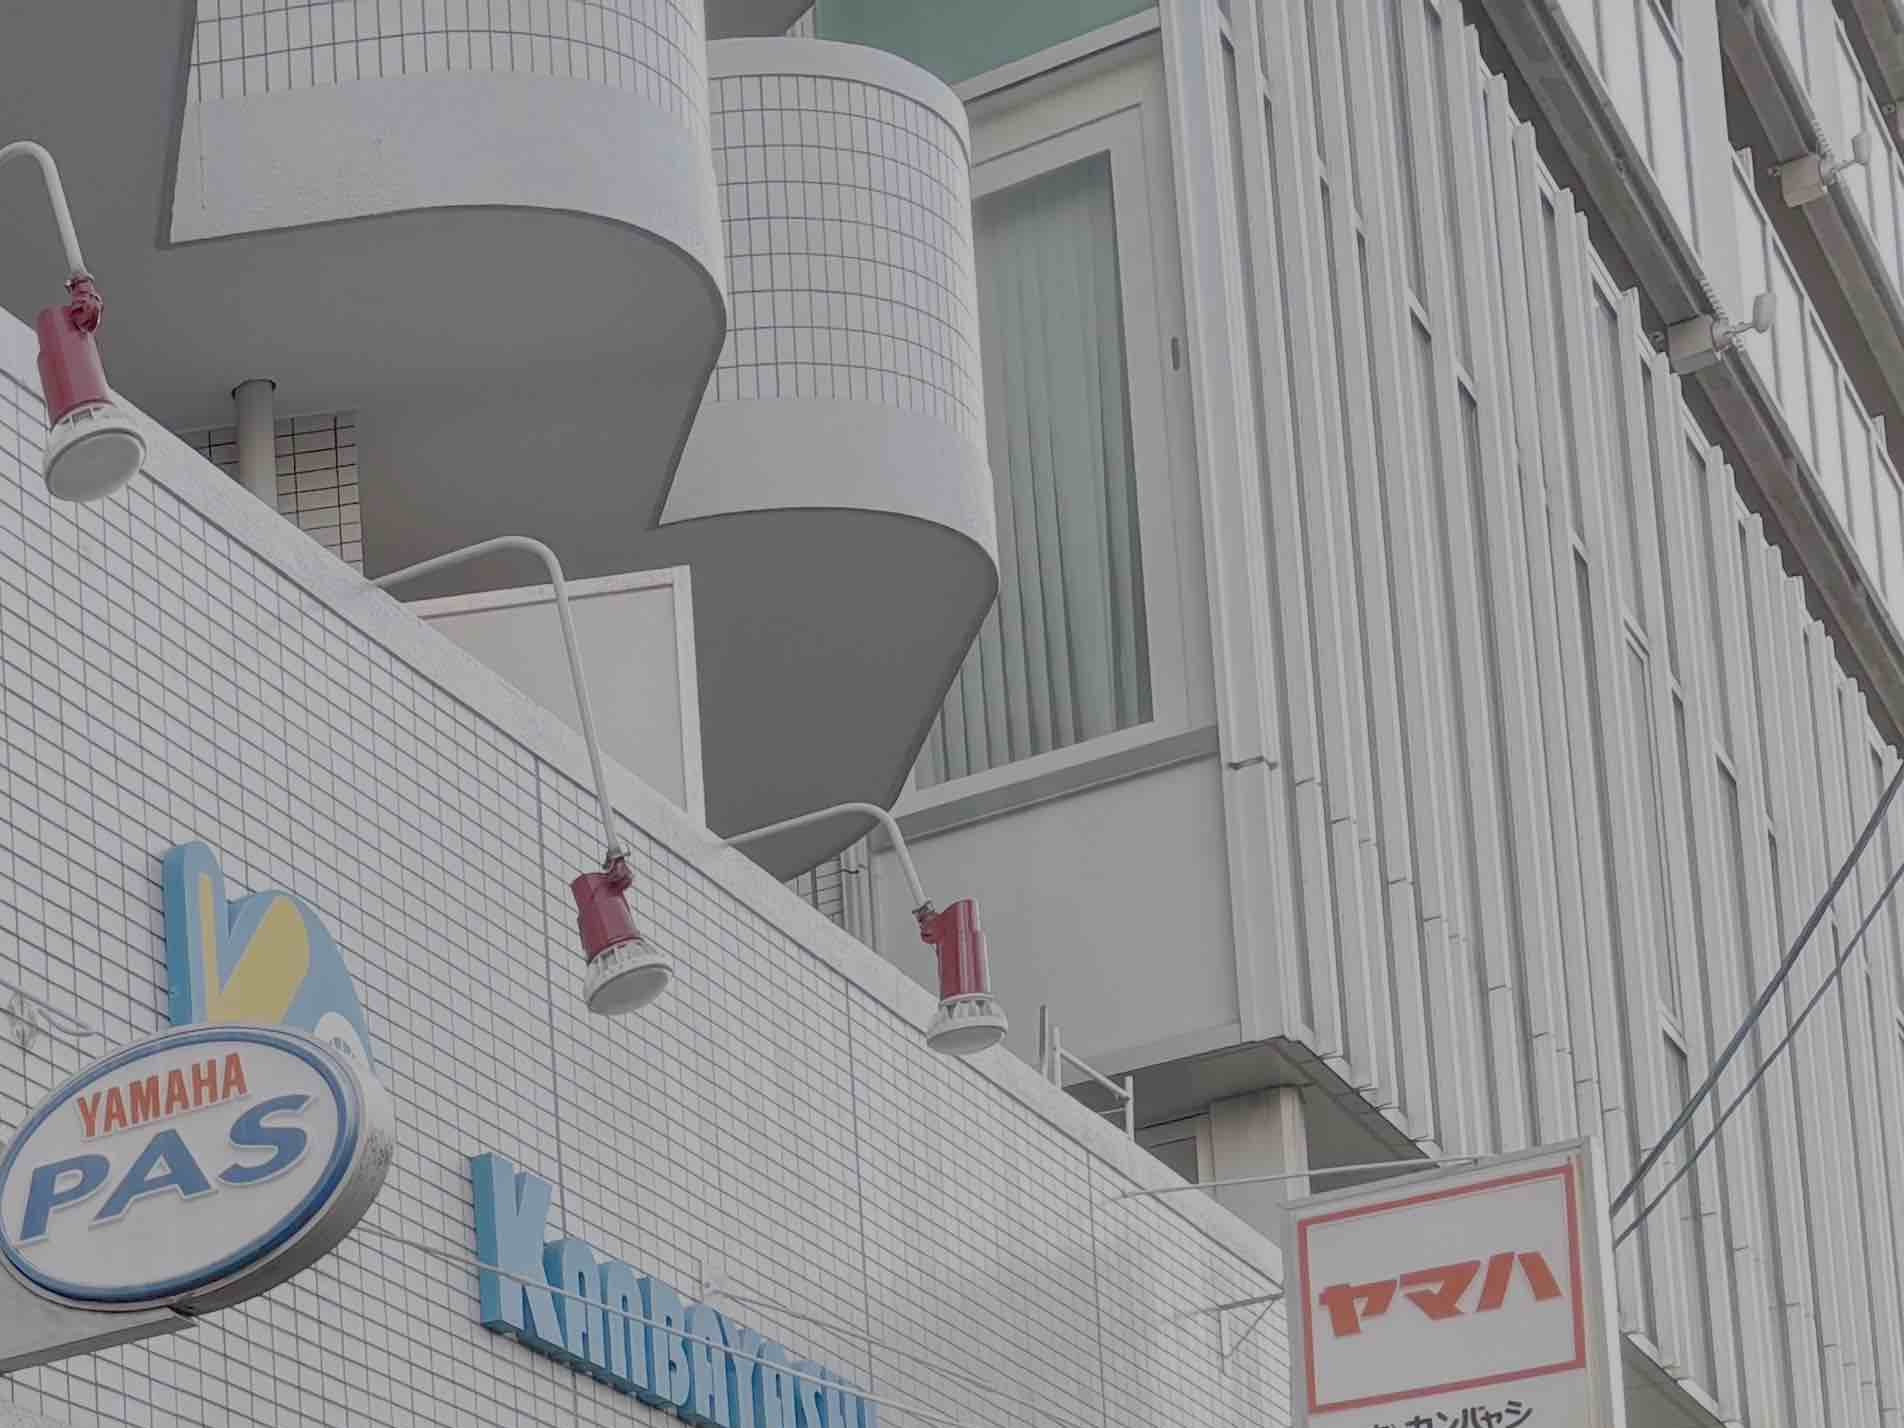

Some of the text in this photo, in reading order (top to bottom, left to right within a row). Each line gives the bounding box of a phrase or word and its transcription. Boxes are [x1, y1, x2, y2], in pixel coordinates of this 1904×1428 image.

[77, 1051, 248, 1138] YAMAHA
[18, 1092, 312, 1246] PAS
[1318, 1251, 1563, 1339] ヤマハ
